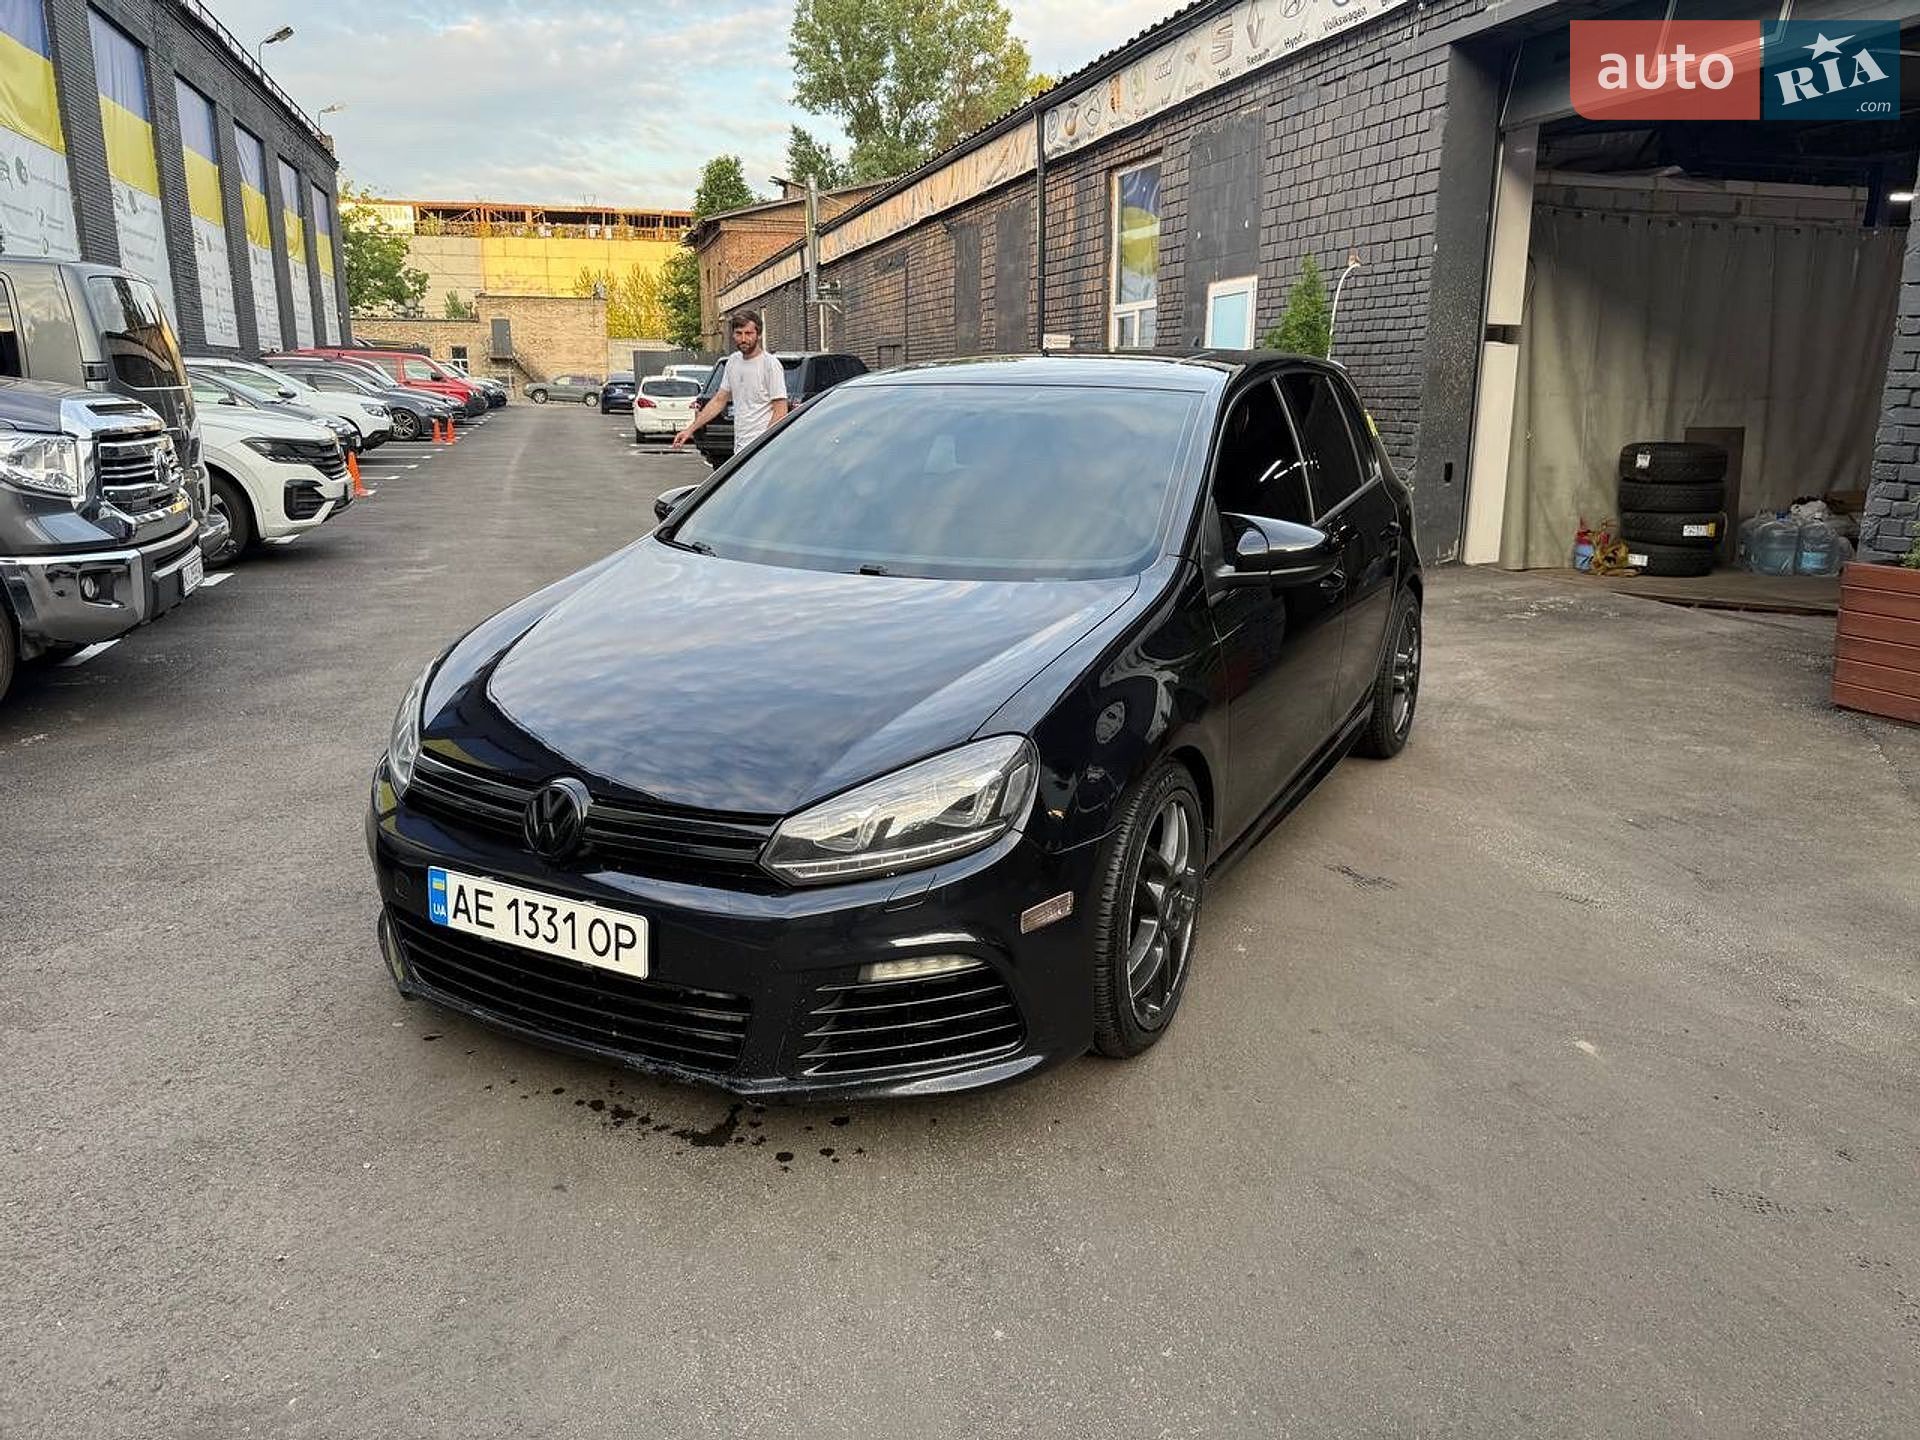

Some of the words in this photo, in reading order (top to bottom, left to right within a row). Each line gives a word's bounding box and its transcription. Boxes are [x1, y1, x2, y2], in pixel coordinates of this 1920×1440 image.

[1323, 6, 1368, 31] Volkswagen
[433, 902, 447, 917] UA
[452, 885, 495, 929] AE
[507, 898, 576, 950] 1331
[588, 918, 637, 961] OP
